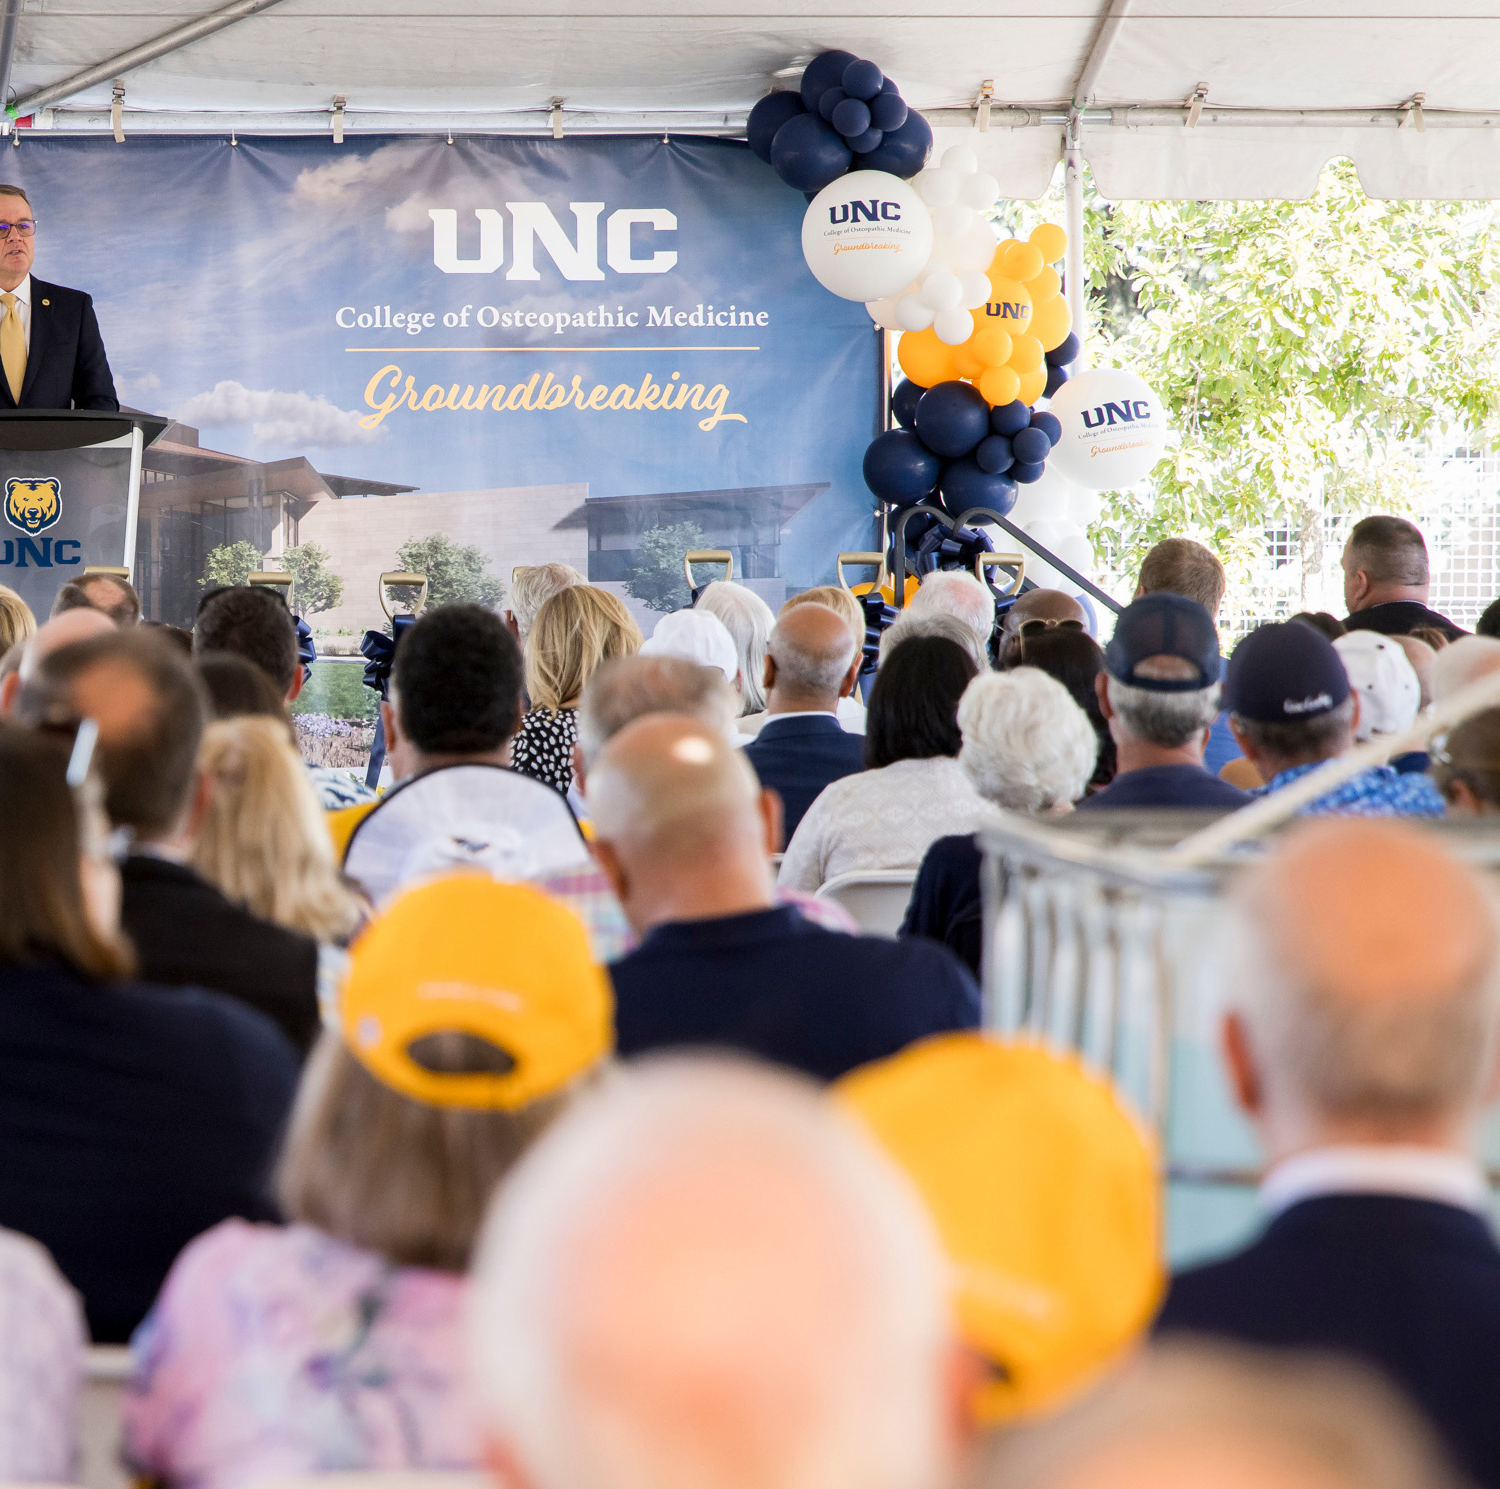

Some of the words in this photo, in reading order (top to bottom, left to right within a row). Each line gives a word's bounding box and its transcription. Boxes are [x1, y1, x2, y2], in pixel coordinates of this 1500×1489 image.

[829, 199, 901, 224] UNC
[428, 201, 678, 281] UNC
[823, 229, 843, 237] College
[850, 225, 886, 233] Osteopathic
[886, 226, 912, 235] Medicine
[833, 241, 903, 255] Groundbreaking
[335, 306, 435, 336] College
[442, 305, 472, 327] of
[476, 305, 639, 334] Osteopathic
[646, 305, 770, 328] Medicine
[985, 301, 1030, 320] UNC
[358, 364, 748, 432] Groundbreaking
[1080, 399, 1151, 429] UNC
